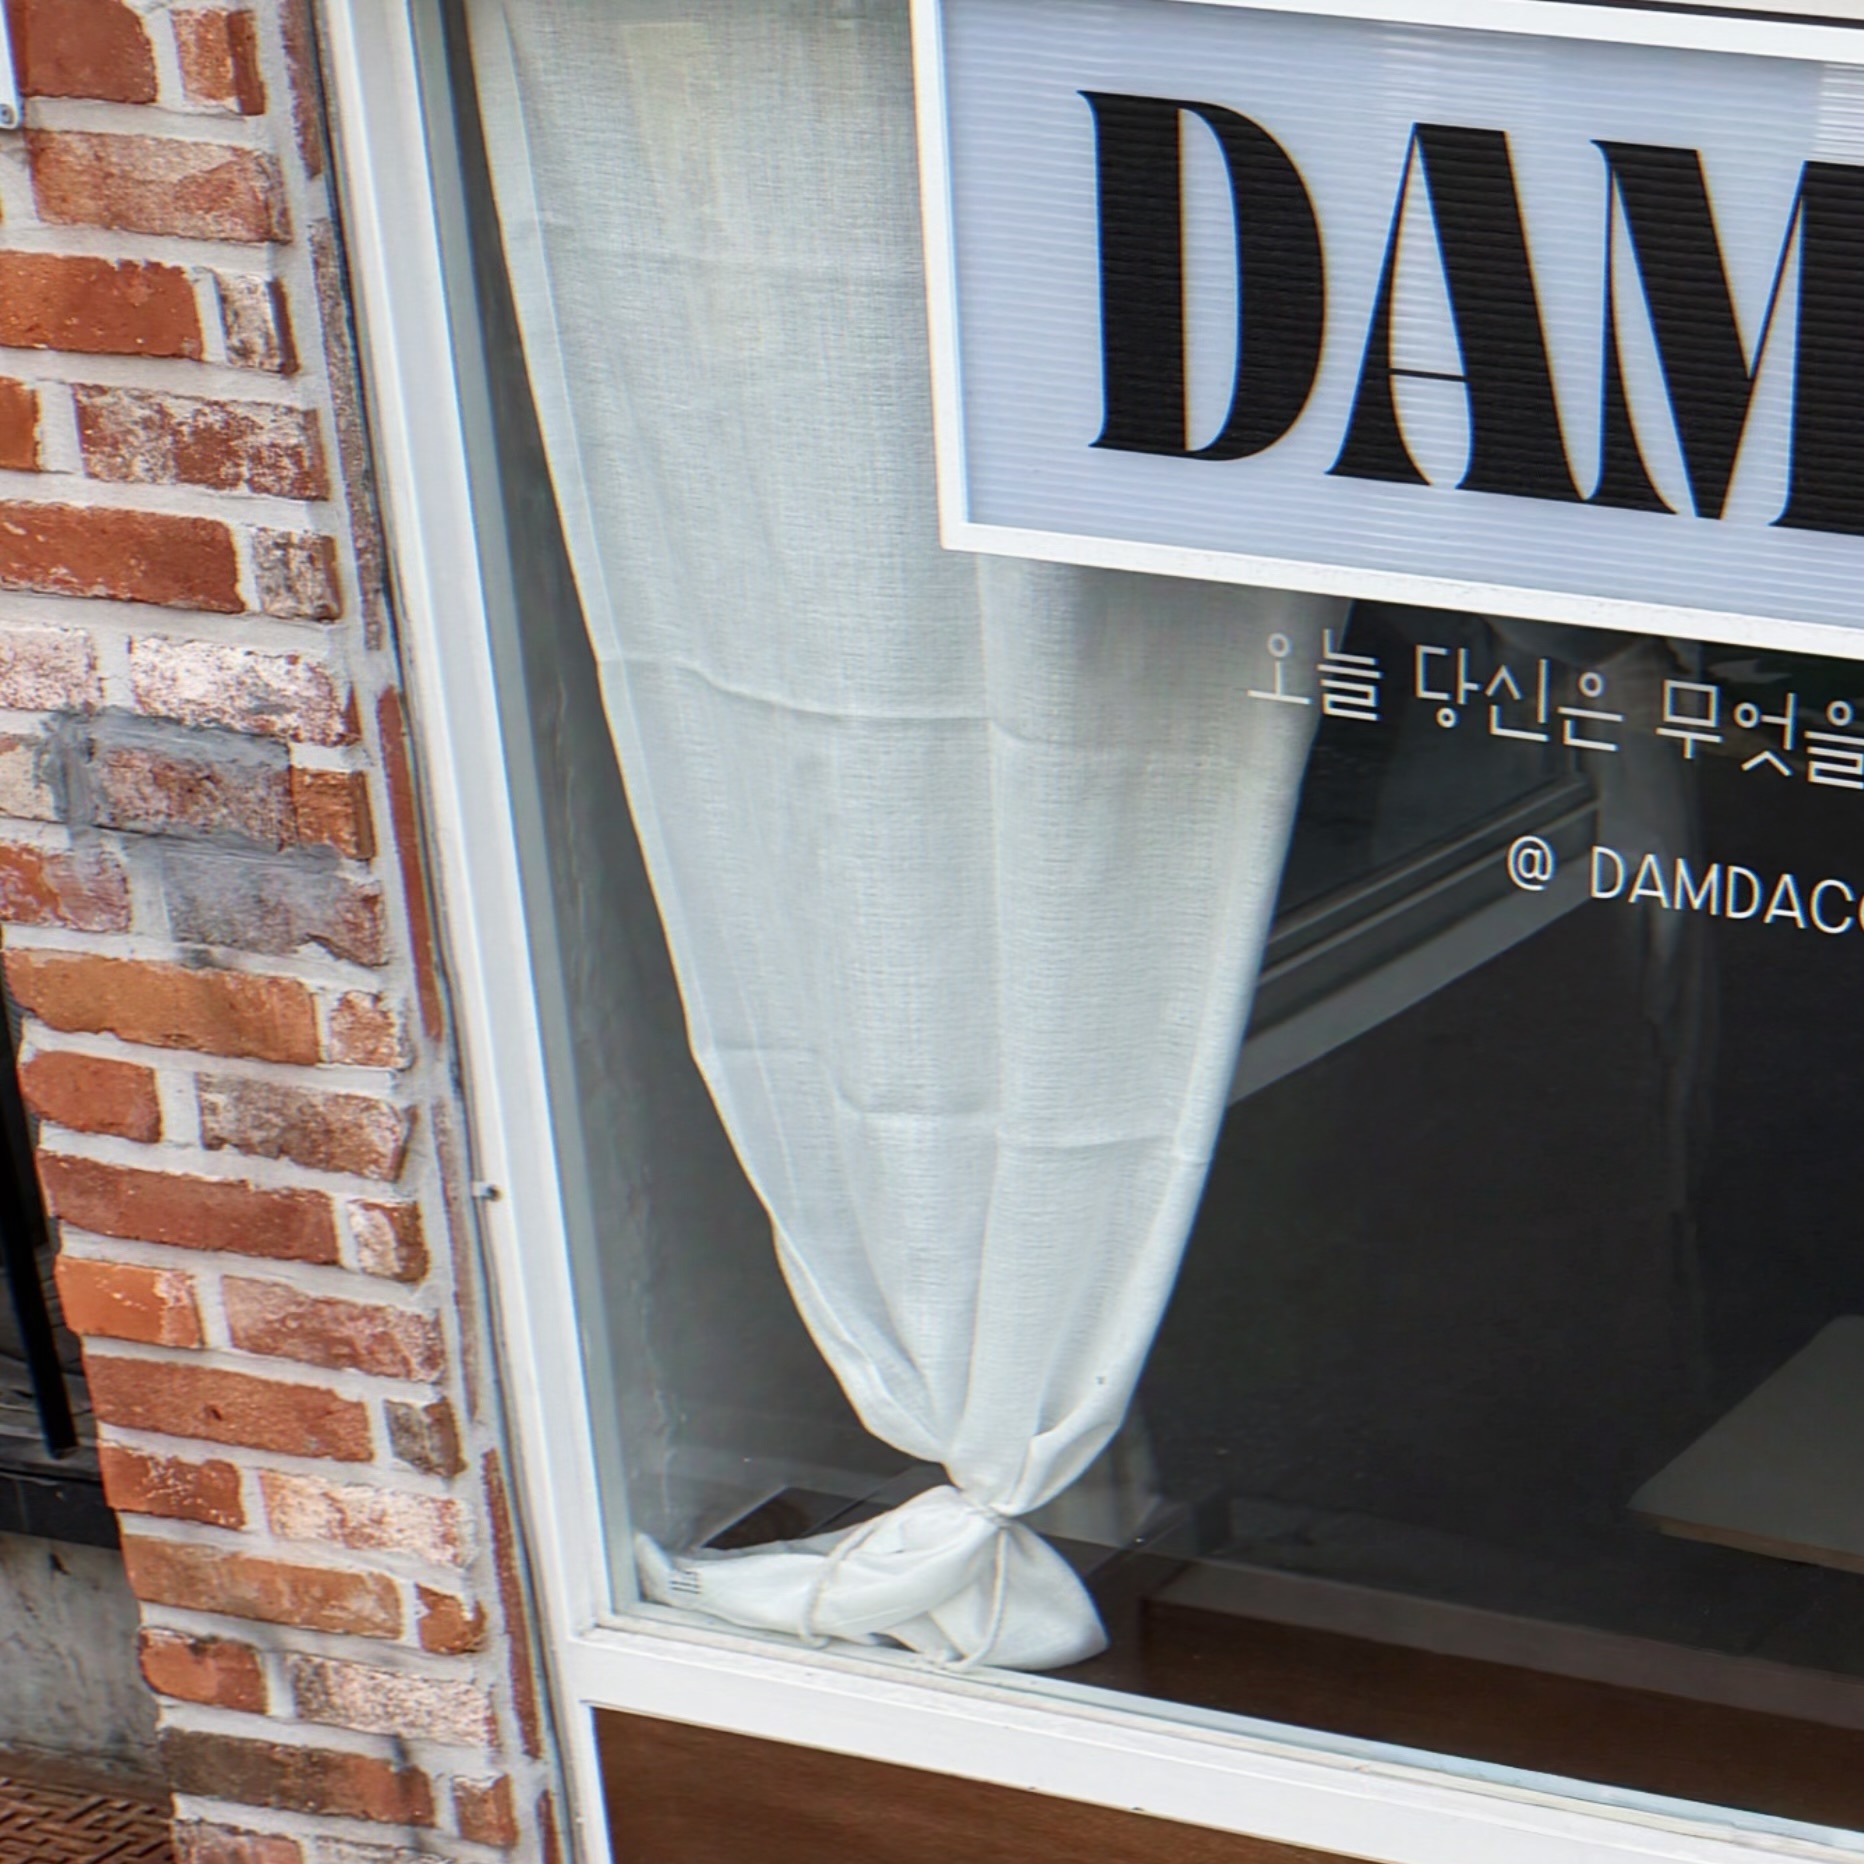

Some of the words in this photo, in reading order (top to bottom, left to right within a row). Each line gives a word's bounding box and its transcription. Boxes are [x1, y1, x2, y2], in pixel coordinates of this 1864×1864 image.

[1247, 628, 1383, 722] 오늘
[1414, 643, 1624, 752] 당신은
[1507, 835, 1555, 890] @
